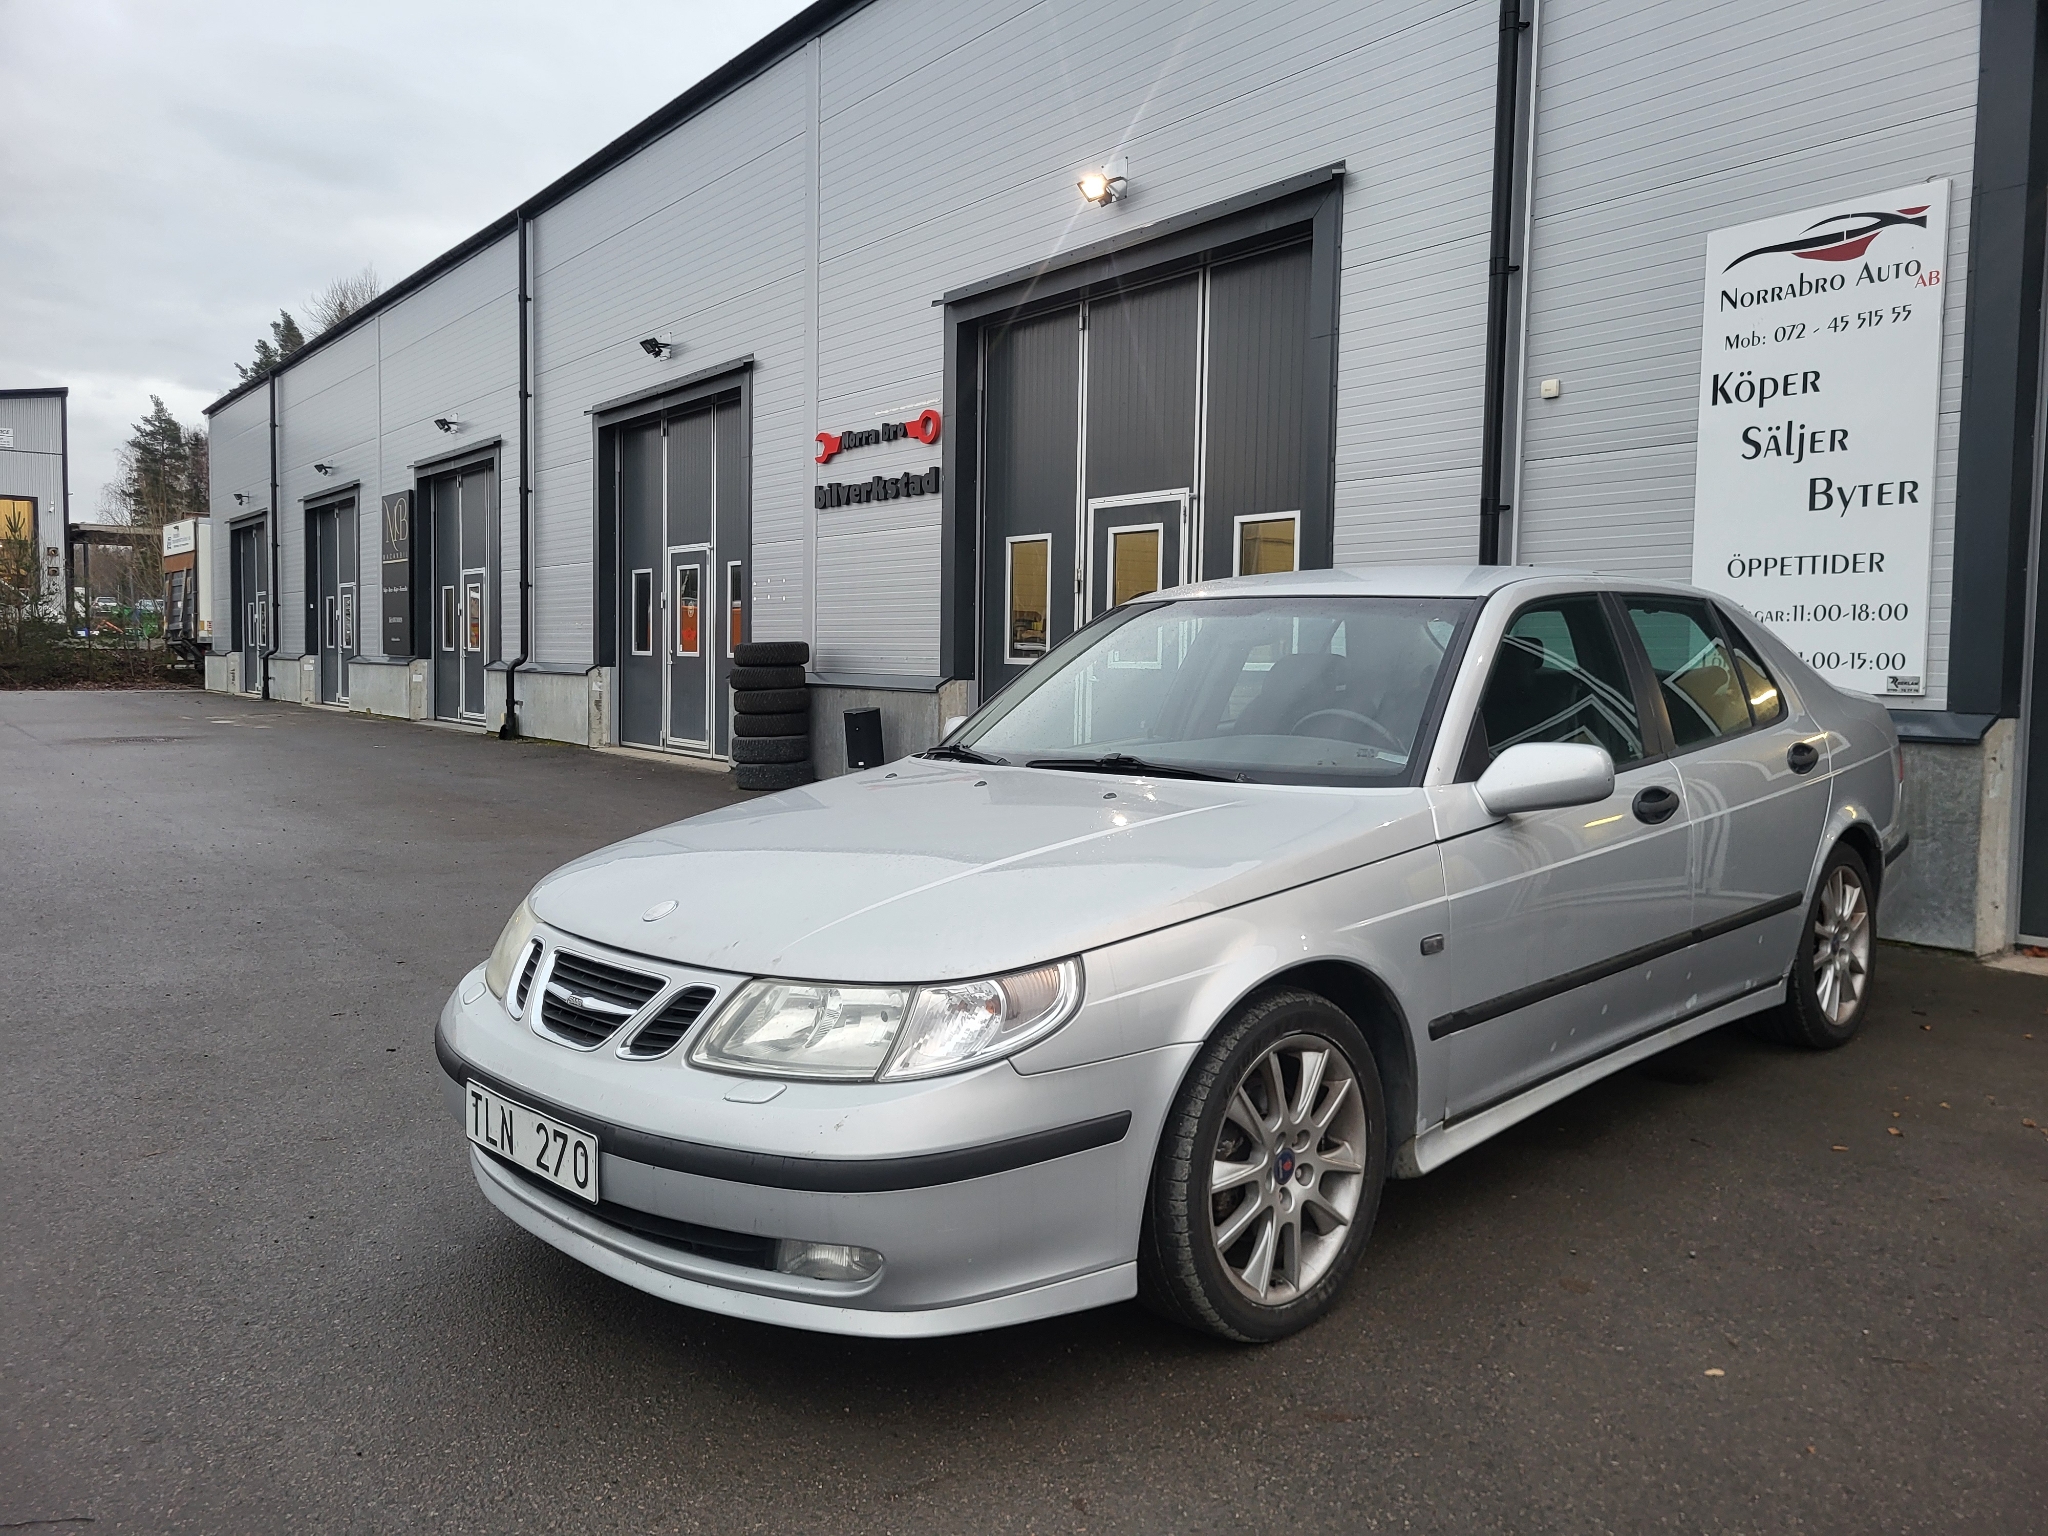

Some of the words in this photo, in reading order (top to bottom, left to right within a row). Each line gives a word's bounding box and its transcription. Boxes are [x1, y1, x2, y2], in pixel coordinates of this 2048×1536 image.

[1856, 259, 1922, 286] AUTO
[1914, 270, 1941, 288] AB
[1724, 331, 1766, 350] Mob:
[1774, 323, 1806, 343] 072
[1827, 315, 1850, 333] 45
[1857, 308, 1884, 330] 515
[1891, 304, 1912, 323] 55
[842, 429, 880, 449] Norra
[815, 466, 939, 509] bilverkstad
[1727, 552, 1885, 578] ÖPPETTIDER
[471, 1089, 514, 1156] TLN
[536, 1122, 589, 1189] 270
